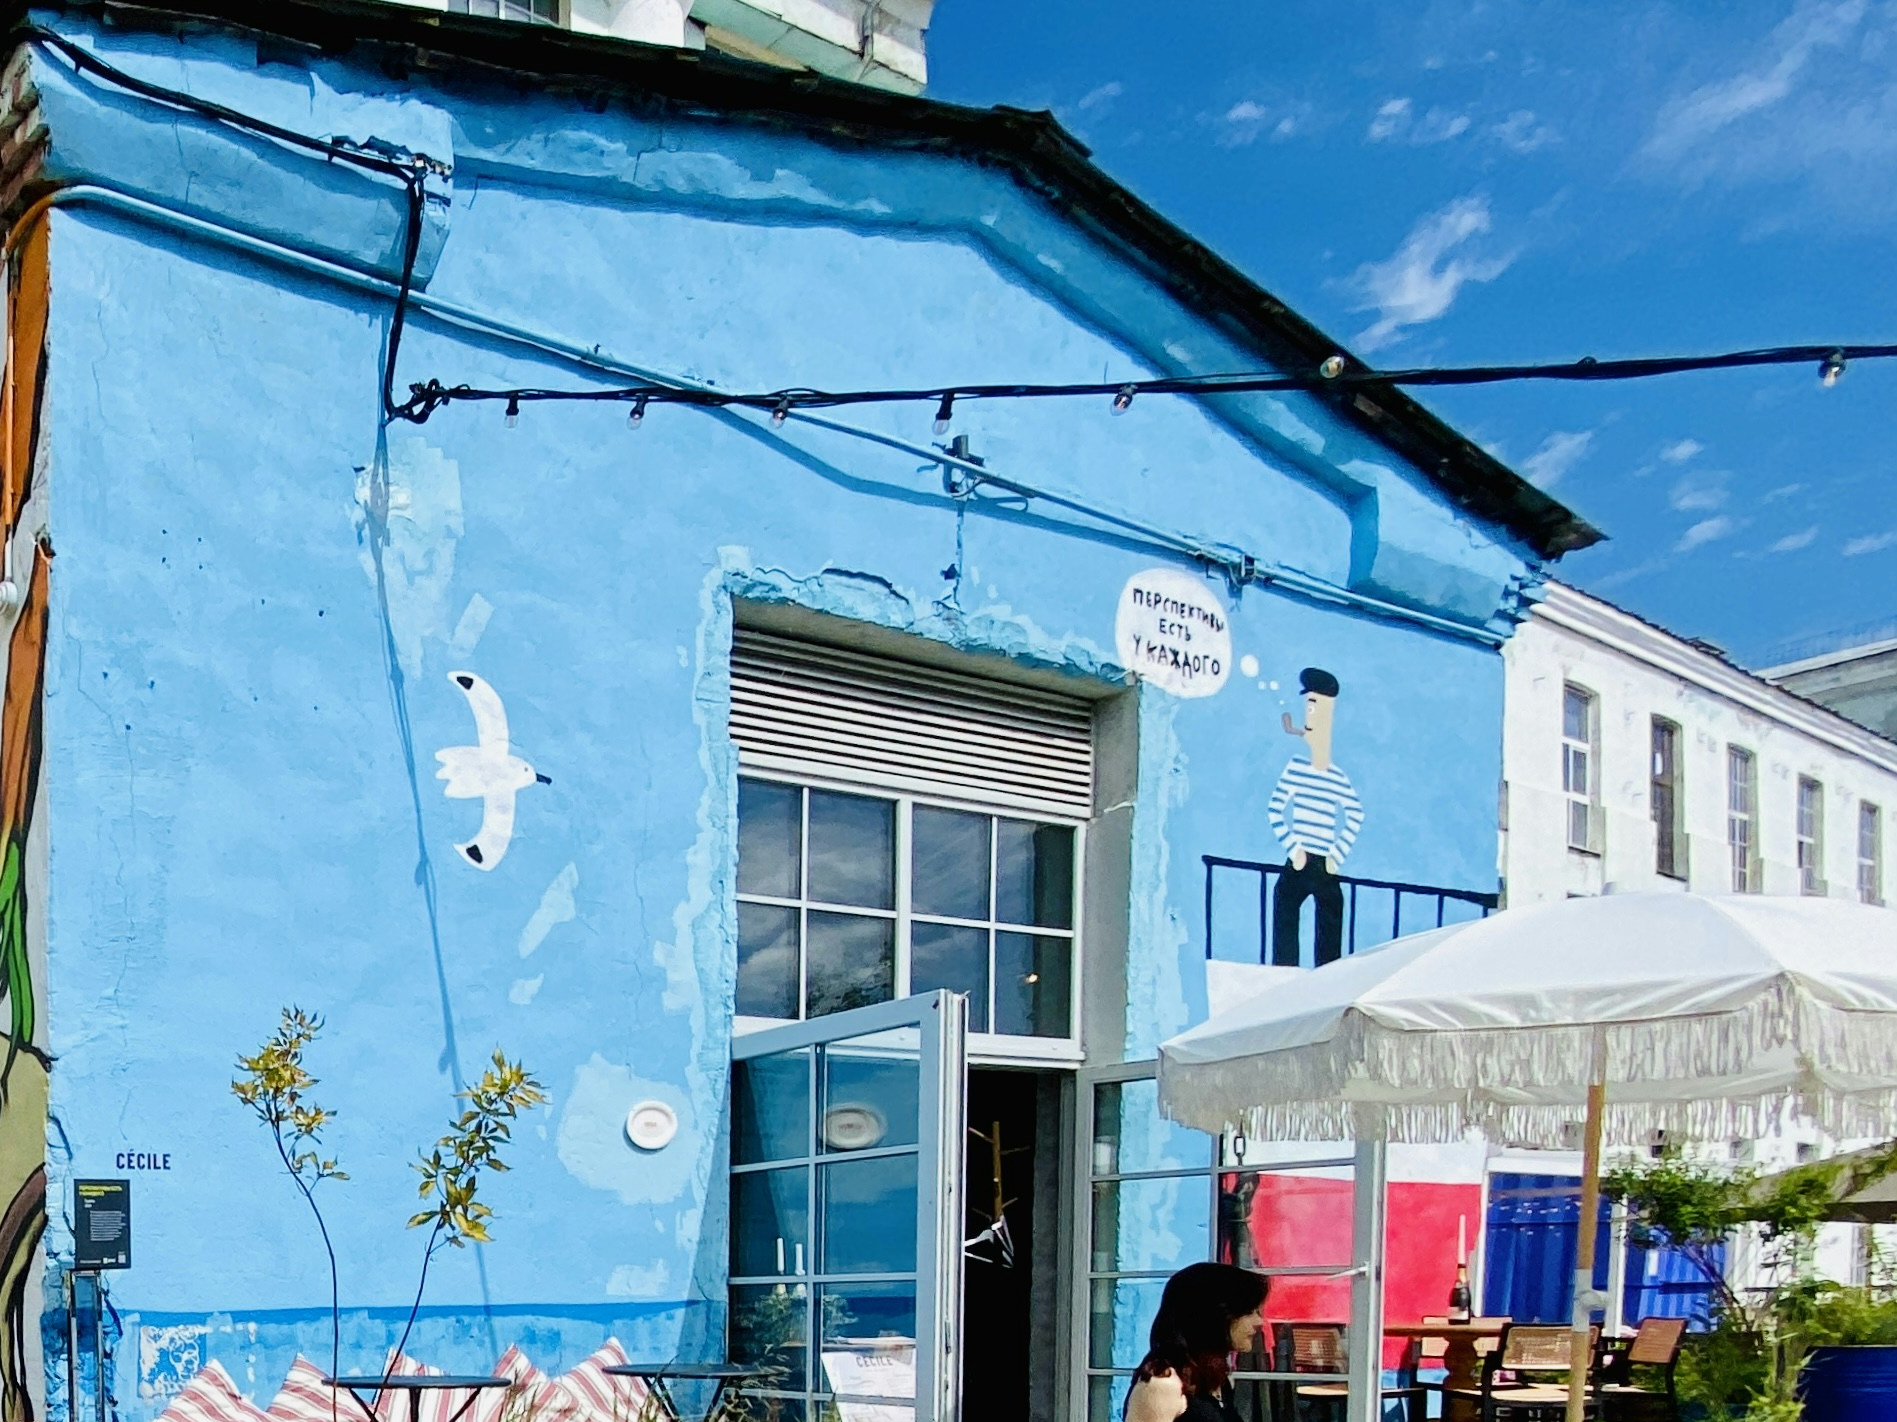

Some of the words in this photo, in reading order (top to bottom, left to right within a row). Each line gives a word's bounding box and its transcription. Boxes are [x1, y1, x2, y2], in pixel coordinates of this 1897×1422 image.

[1132, 587, 1224, 632] ПЕРСПЕКТИВЫ
[1159, 618, 1192, 642] ЕСТЬ
[1133, 633, 1142, 657] У
[1146, 640, 1221, 679] КАЖДОГО
[115, 1148, 172, 1171] CÉCILE
